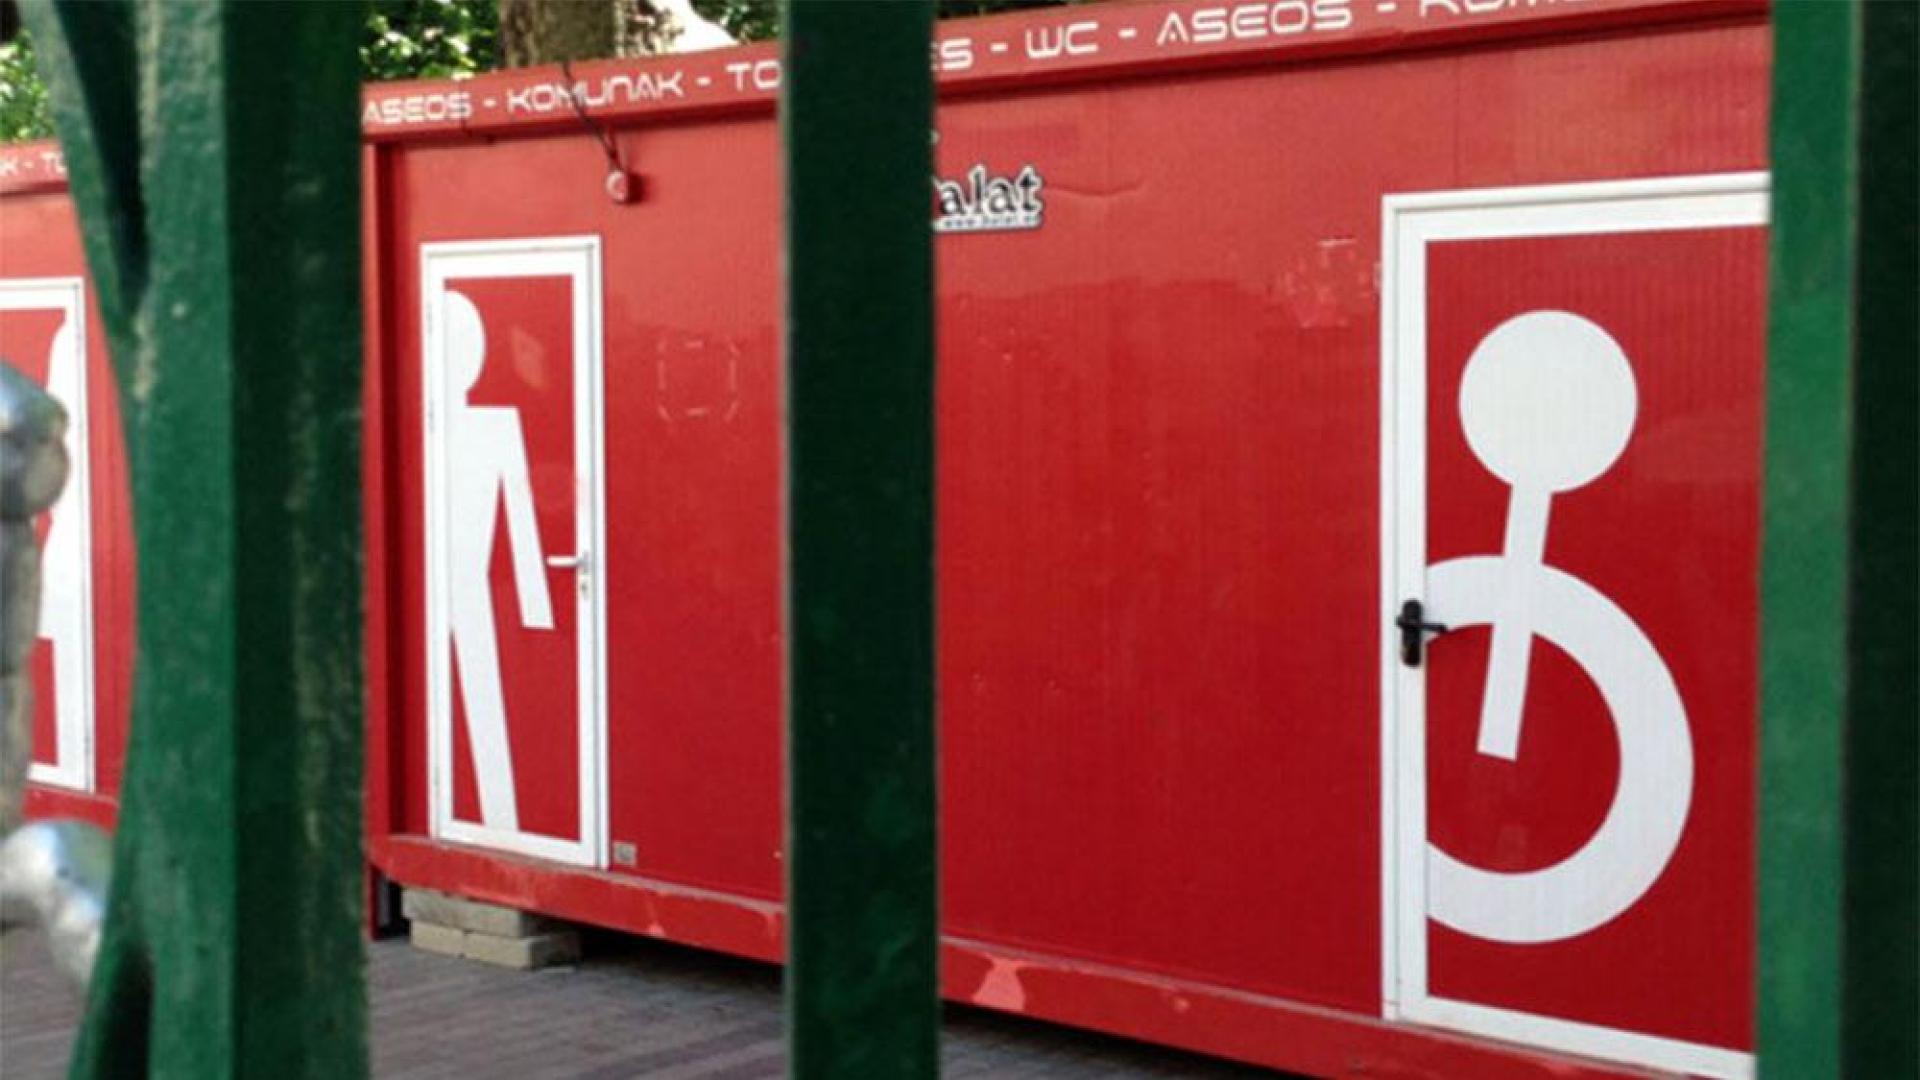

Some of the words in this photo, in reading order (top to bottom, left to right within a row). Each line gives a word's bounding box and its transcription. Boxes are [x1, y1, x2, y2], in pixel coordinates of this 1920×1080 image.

[363, 92, 473, 125] ASEOS
[507, 71, 684, 113] KOMUNAK
[930, 38, 973, 71] S
[1025, 21, 1099, 58] WC
[1156, 0, 1353, 45] ASEOS
